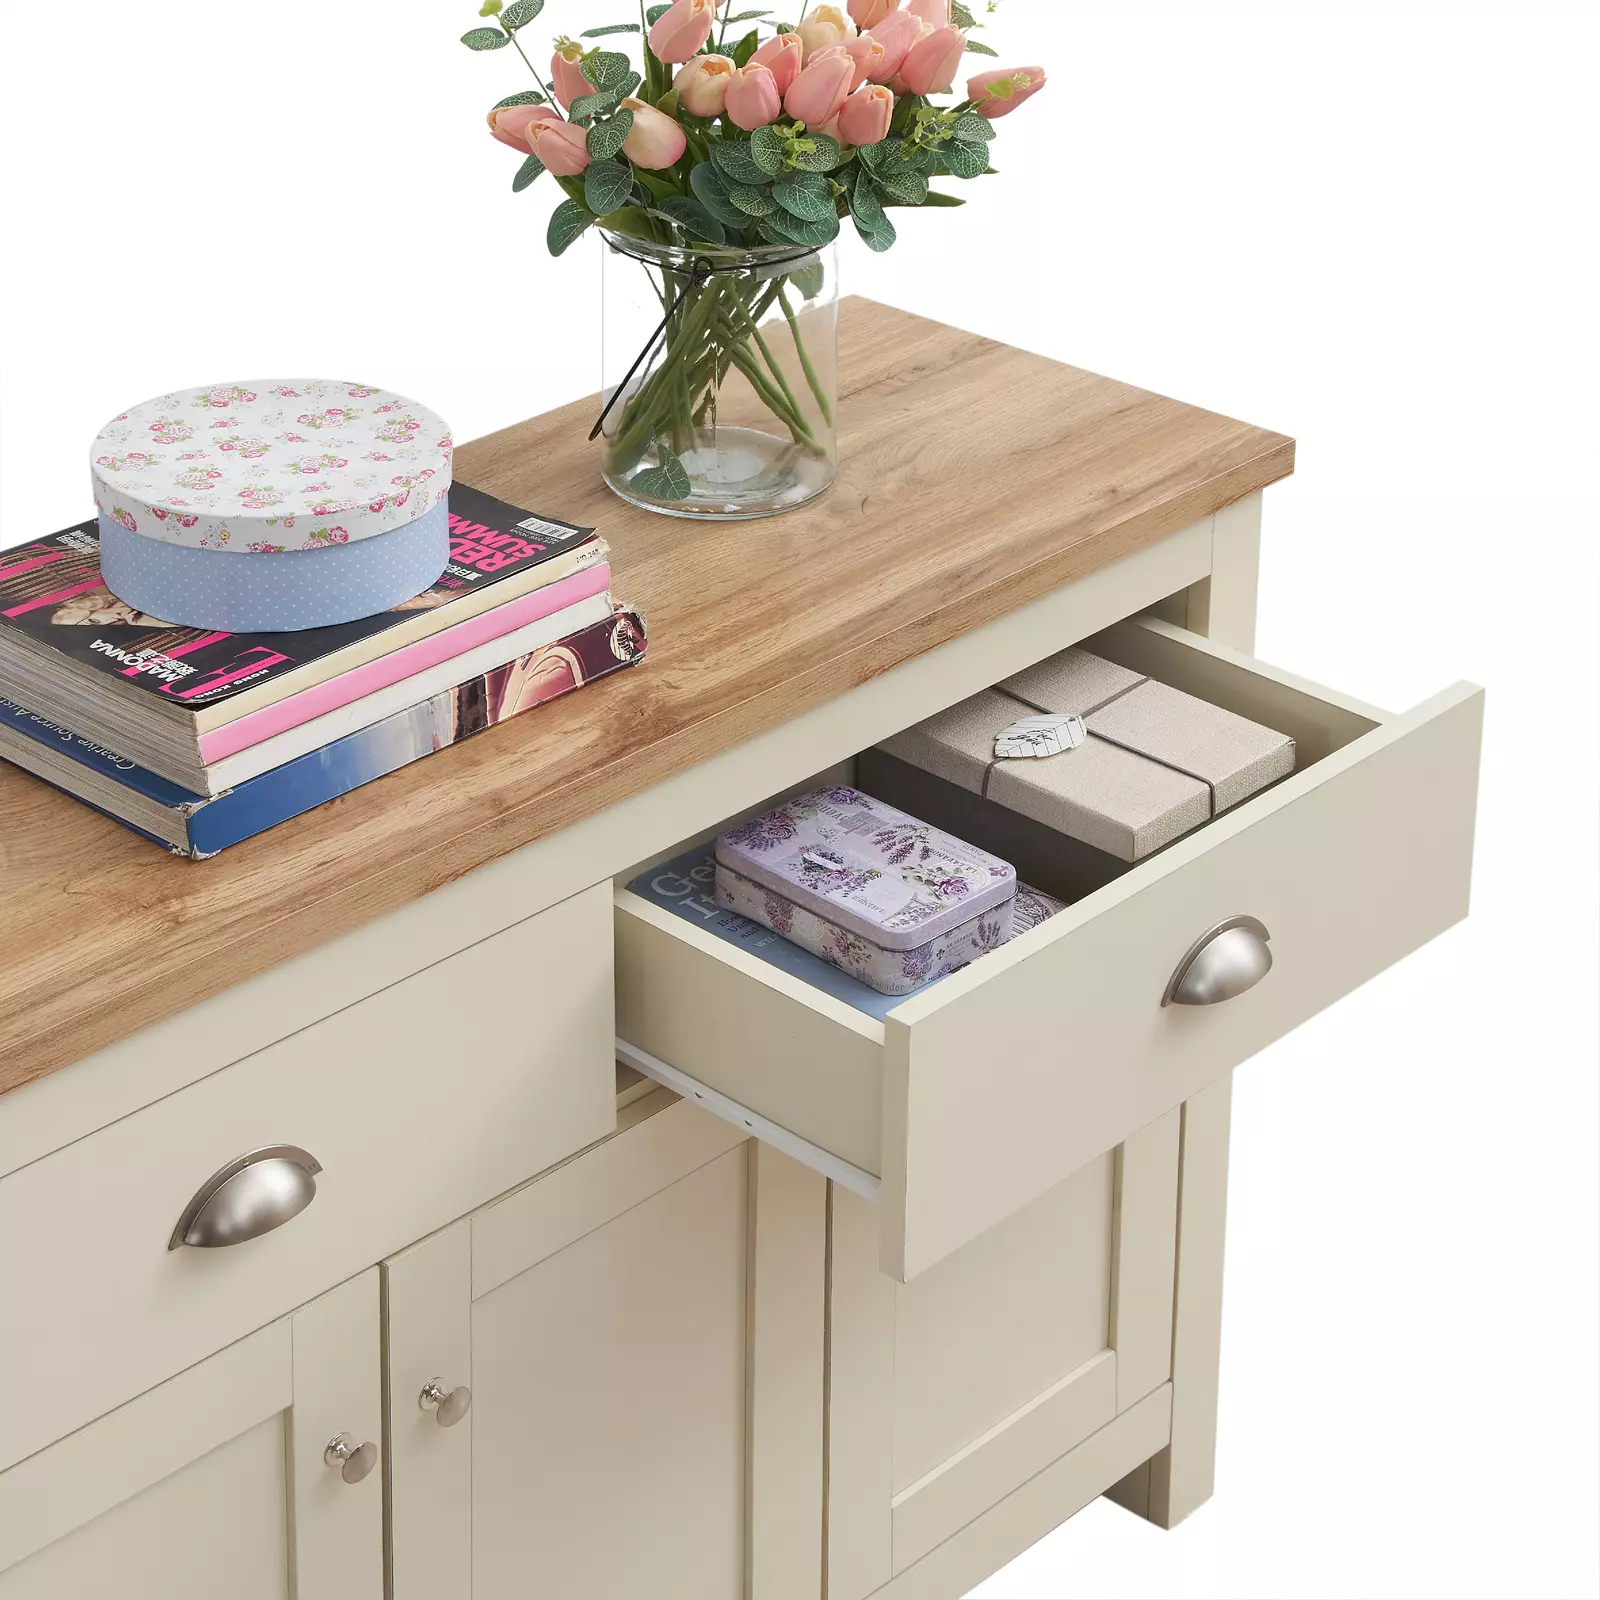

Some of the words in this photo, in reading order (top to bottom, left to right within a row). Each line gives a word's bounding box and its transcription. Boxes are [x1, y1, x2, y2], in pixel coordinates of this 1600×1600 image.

[449, 512, 547, 558] SUMM
[89, 639, 183, 682] MADONNA
[233, 669, 269, 685] HONG
[194, 684, 231, 699] KONG
[0, 698, 30, 716] Aus
[31, 715, 75, 741] Source
[78, 739, 136, 769] Creative
[727, 919, 751, 933] Unde
[740, 927, 760, 939] and
